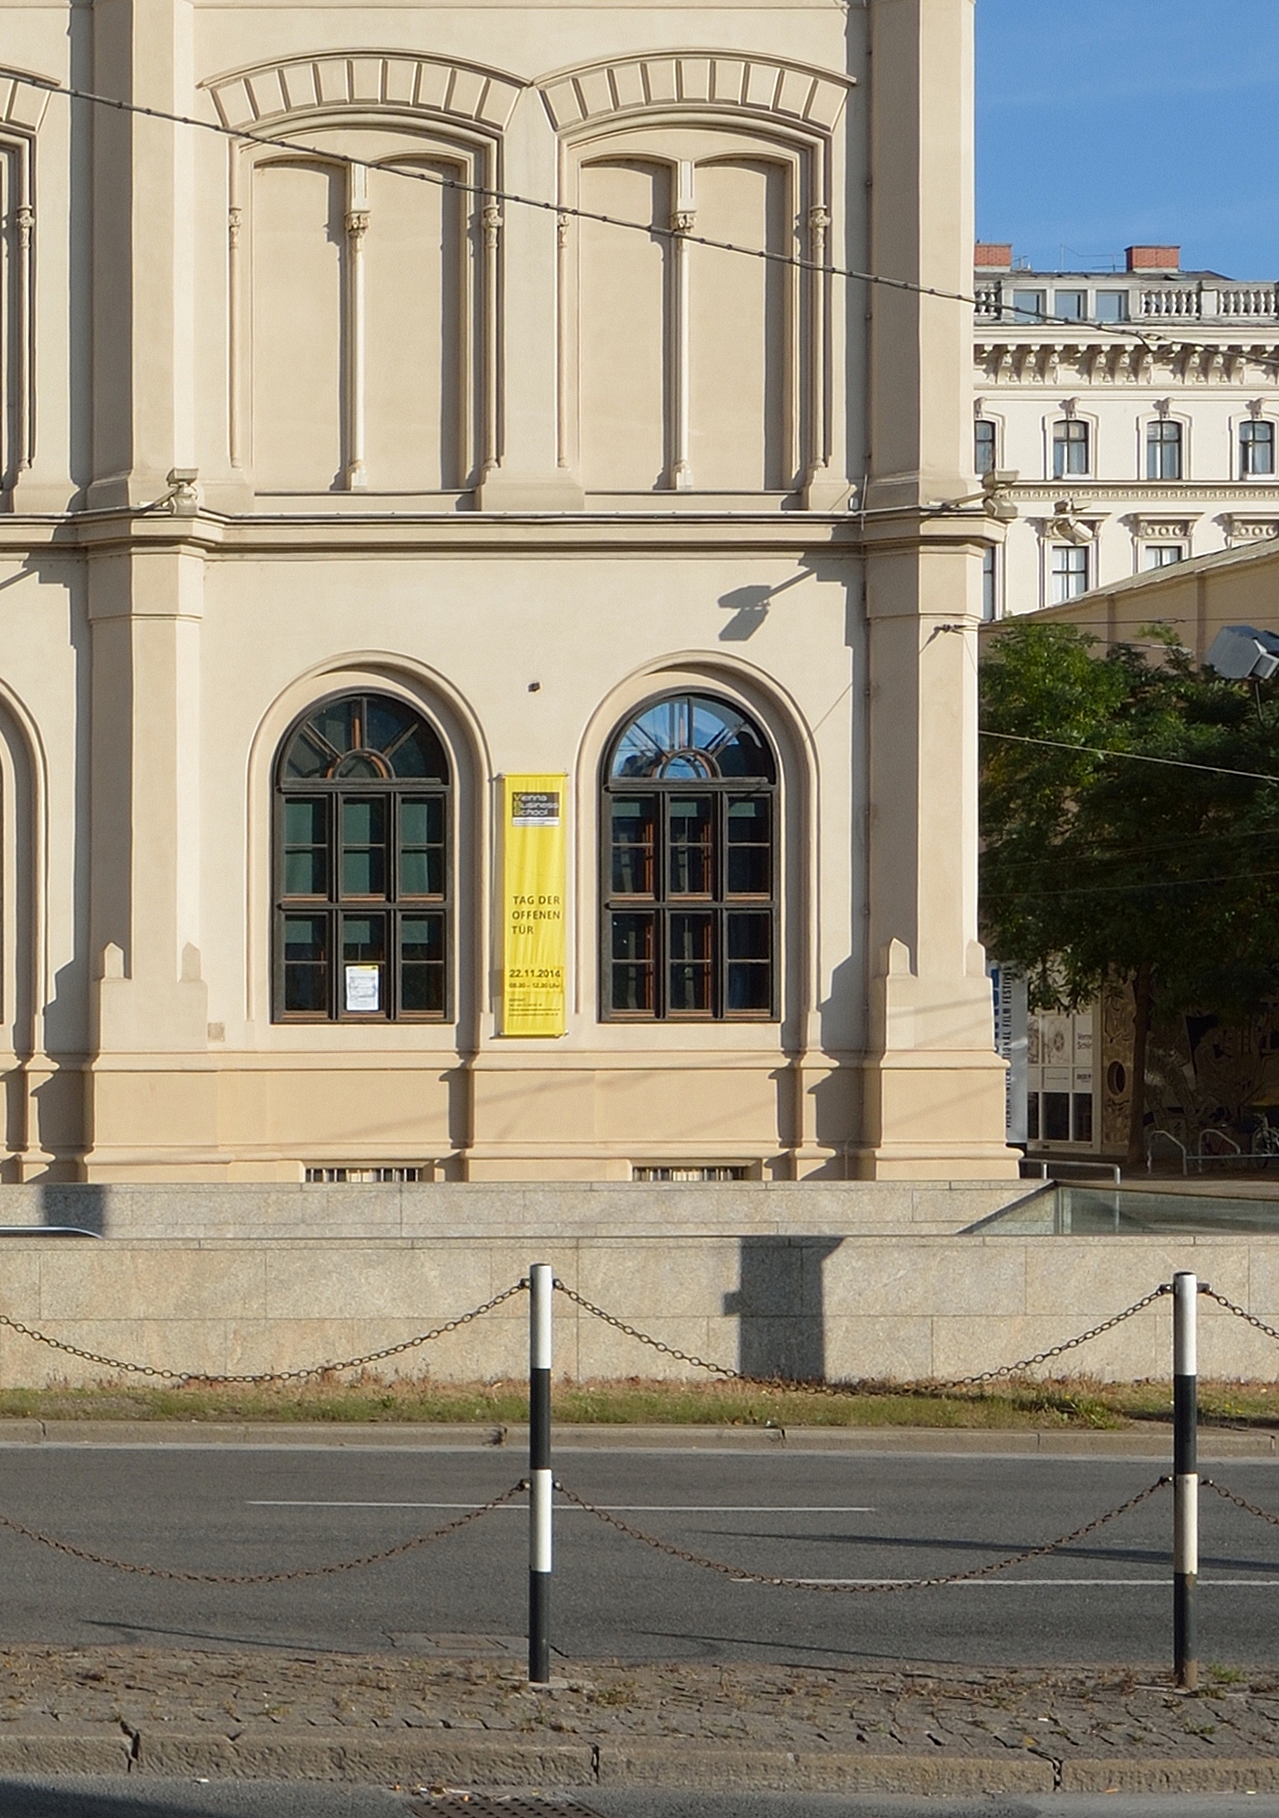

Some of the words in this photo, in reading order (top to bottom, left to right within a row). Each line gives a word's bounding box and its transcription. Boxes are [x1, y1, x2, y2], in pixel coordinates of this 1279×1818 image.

[512, 895, 534, 905] TAG
[538, 895, 560, 905] DER
[512, 910, 560, 920] OFFENEN
[509, 969, 561, 978] 22.11.2014
[1002, 1008, 1012, 1027] FILM
